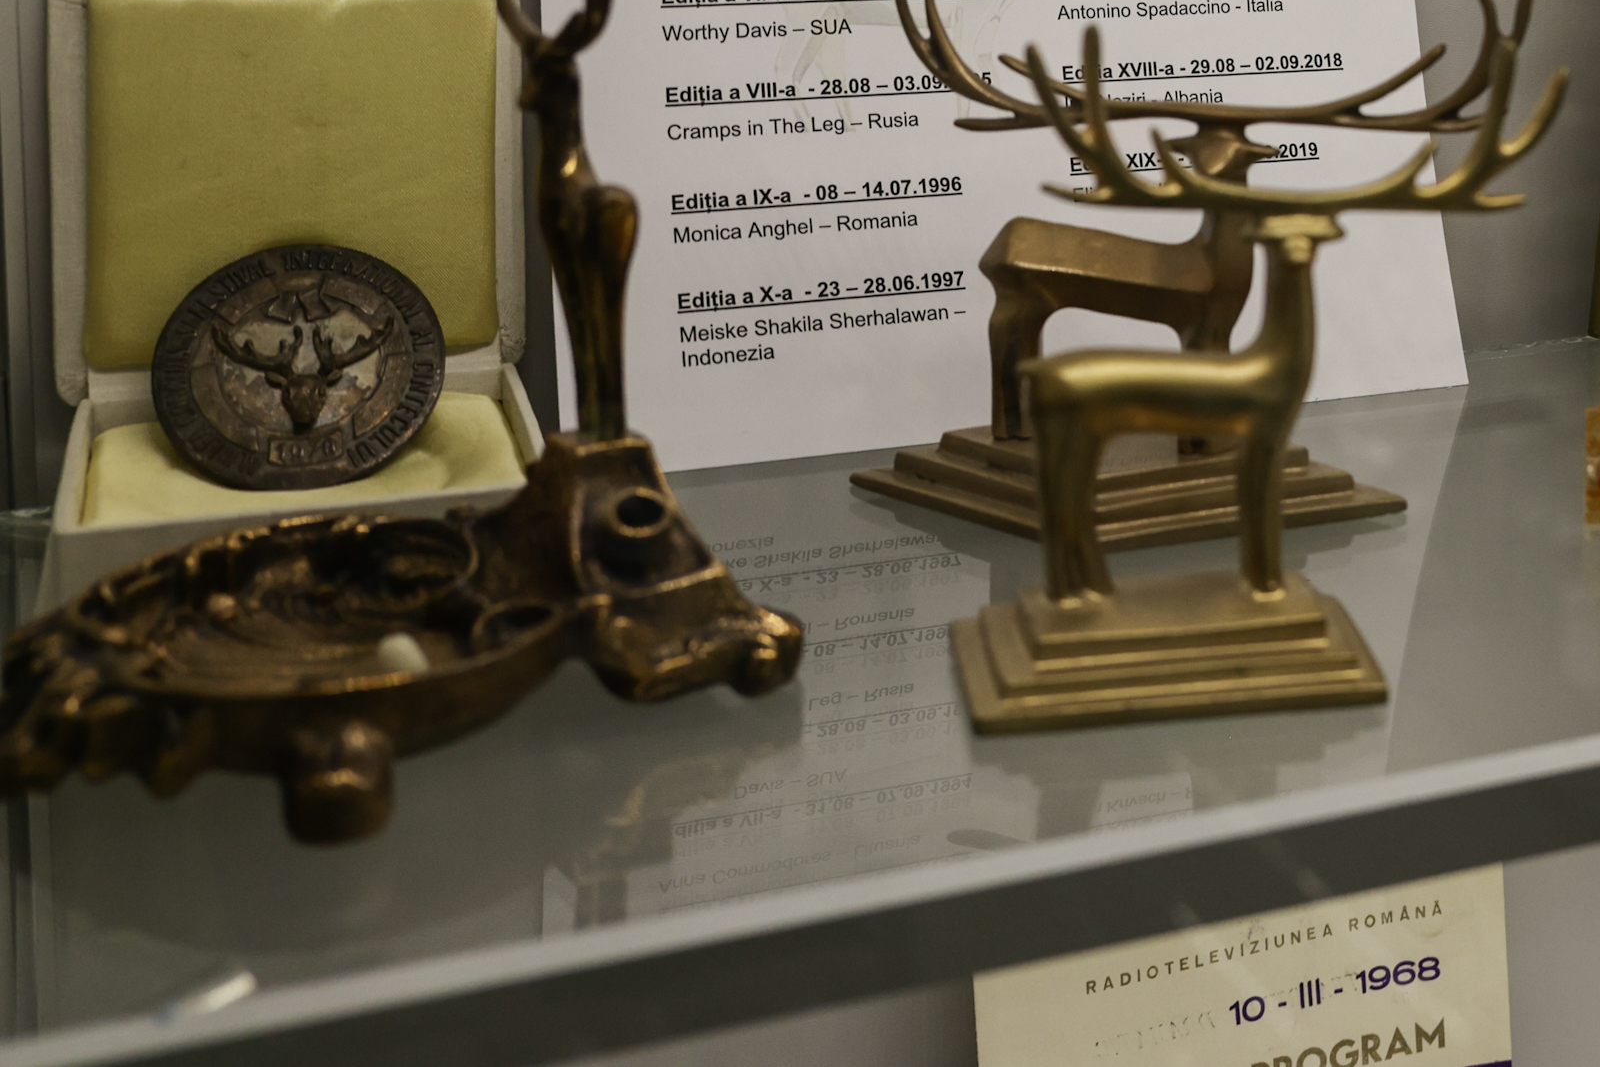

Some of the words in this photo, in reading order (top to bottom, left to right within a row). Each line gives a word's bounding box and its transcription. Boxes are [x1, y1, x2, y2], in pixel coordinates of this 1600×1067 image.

[1058, 2, 1131, 22] Antonino
[1137, 0, 1230, 22] Spadaccino
[662, 23, 729, 46] Worthy
[736, 20, 787, 40] Davis
[811, 17, 852, 37] SUA
[1190, 58, 1235, 75] 29.08
[1255, 52, 1343, 71] 02.09.2018
[746, 81, 796, 101] VIII-a
[820, 77, 870, 98] 28.08
[667, 123, 741, 145] Cramps
[769, 117, 805, 137] The
[811, 116, 845, 138] Leg
[868, 110, 919, 132] Rusia
[753, 187, 791, 207] IX-a
[862, 175, 962, 199] 14.07.1996
[673, 224, 742, 245] Monica
[748, 217, 813, 243] Anghel
[837, 210, 918, 234] Romania
[760, 284, 793, 304] X-a
[864, 269, 963, 296] 28.06.1997
[680, 322, 748, 344] Meiske
[755, 314, 823, 338] Shakila
[830, 307, 948, 331] Sherhalawan
[682, 343, 775, 369] Indonezia
[1085, 922, 1334, 995] RADIOTELEVIZIUNEA
[1347, 900, 1444, 932] ROMÂNĂ
[1229, 996, 1266, 1026] 10
[1299, 977, 1322, 1009] III
[1355, 956, 1442, 994] 1968
